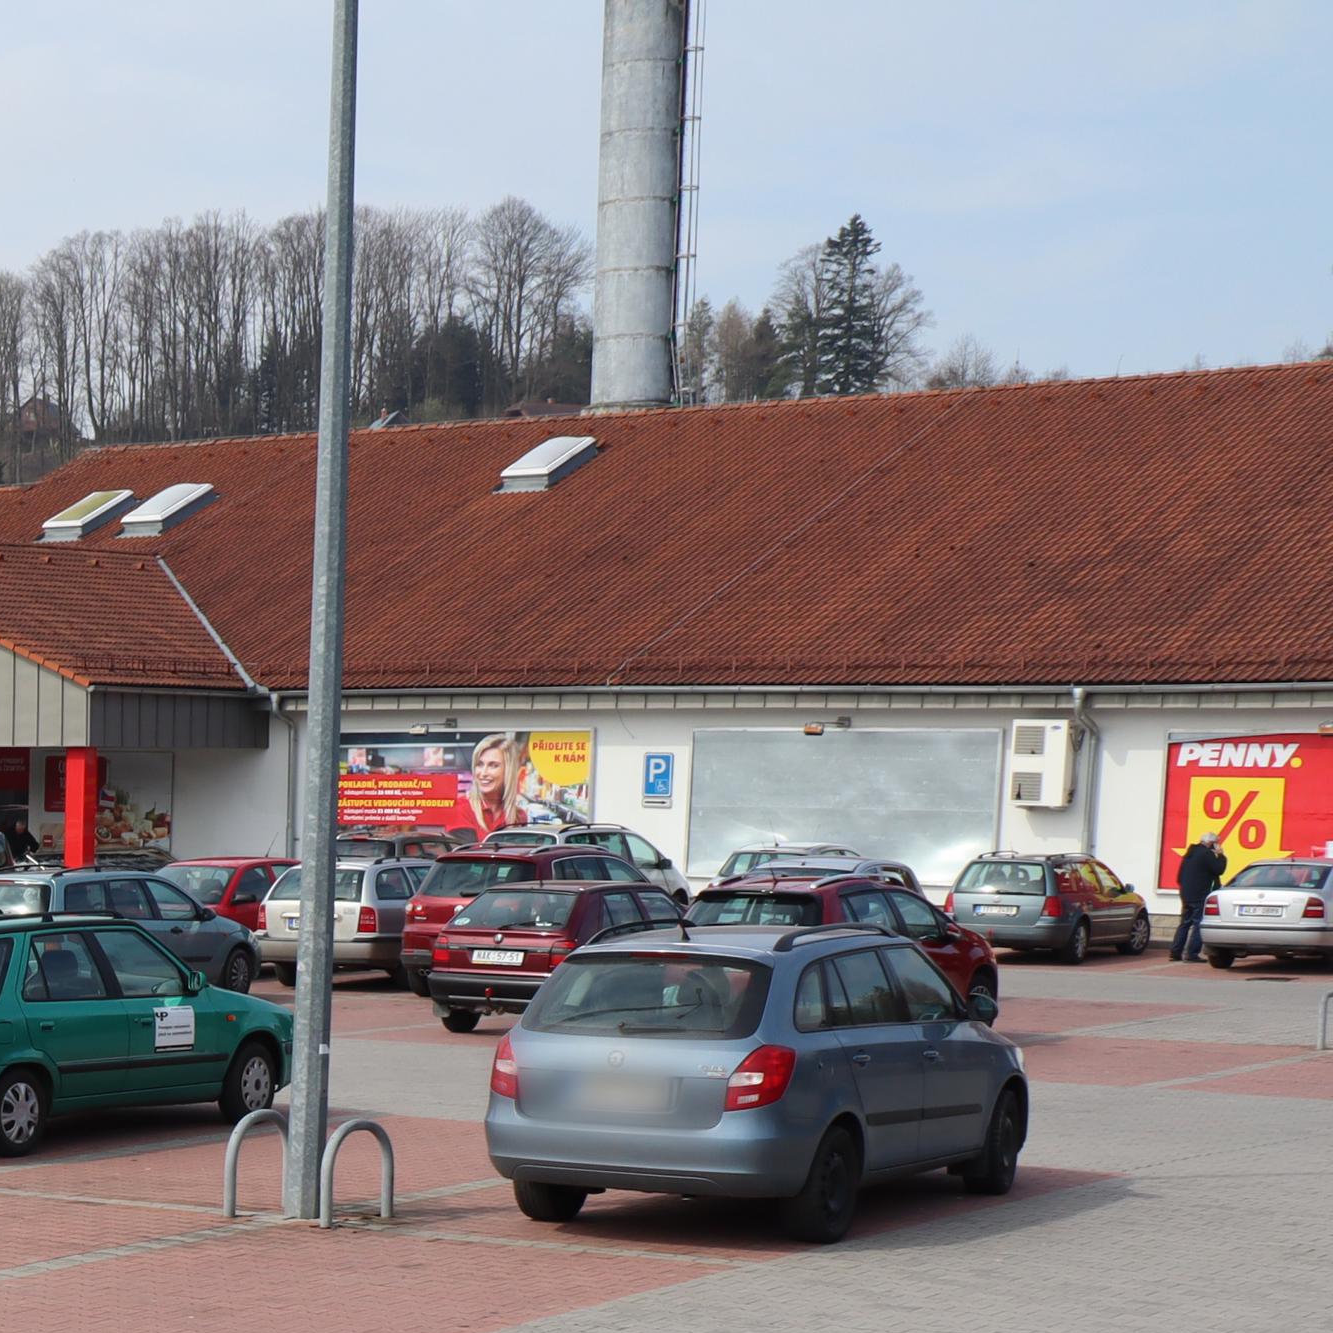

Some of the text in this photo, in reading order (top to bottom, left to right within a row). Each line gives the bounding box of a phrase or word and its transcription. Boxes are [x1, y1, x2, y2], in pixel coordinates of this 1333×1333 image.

[532, 740, 586, 751] PŘIDEJTE SE
[554, 752, 586, 762] K NÁM
[649, 758, 667, 783] P
[338, 779, 432, 789] POKLADNÍ, PRODAVAČ/KA
[337, 798, 455, 808] ZÁSTUPCE VEDOUCÍHO PRODEJNY
